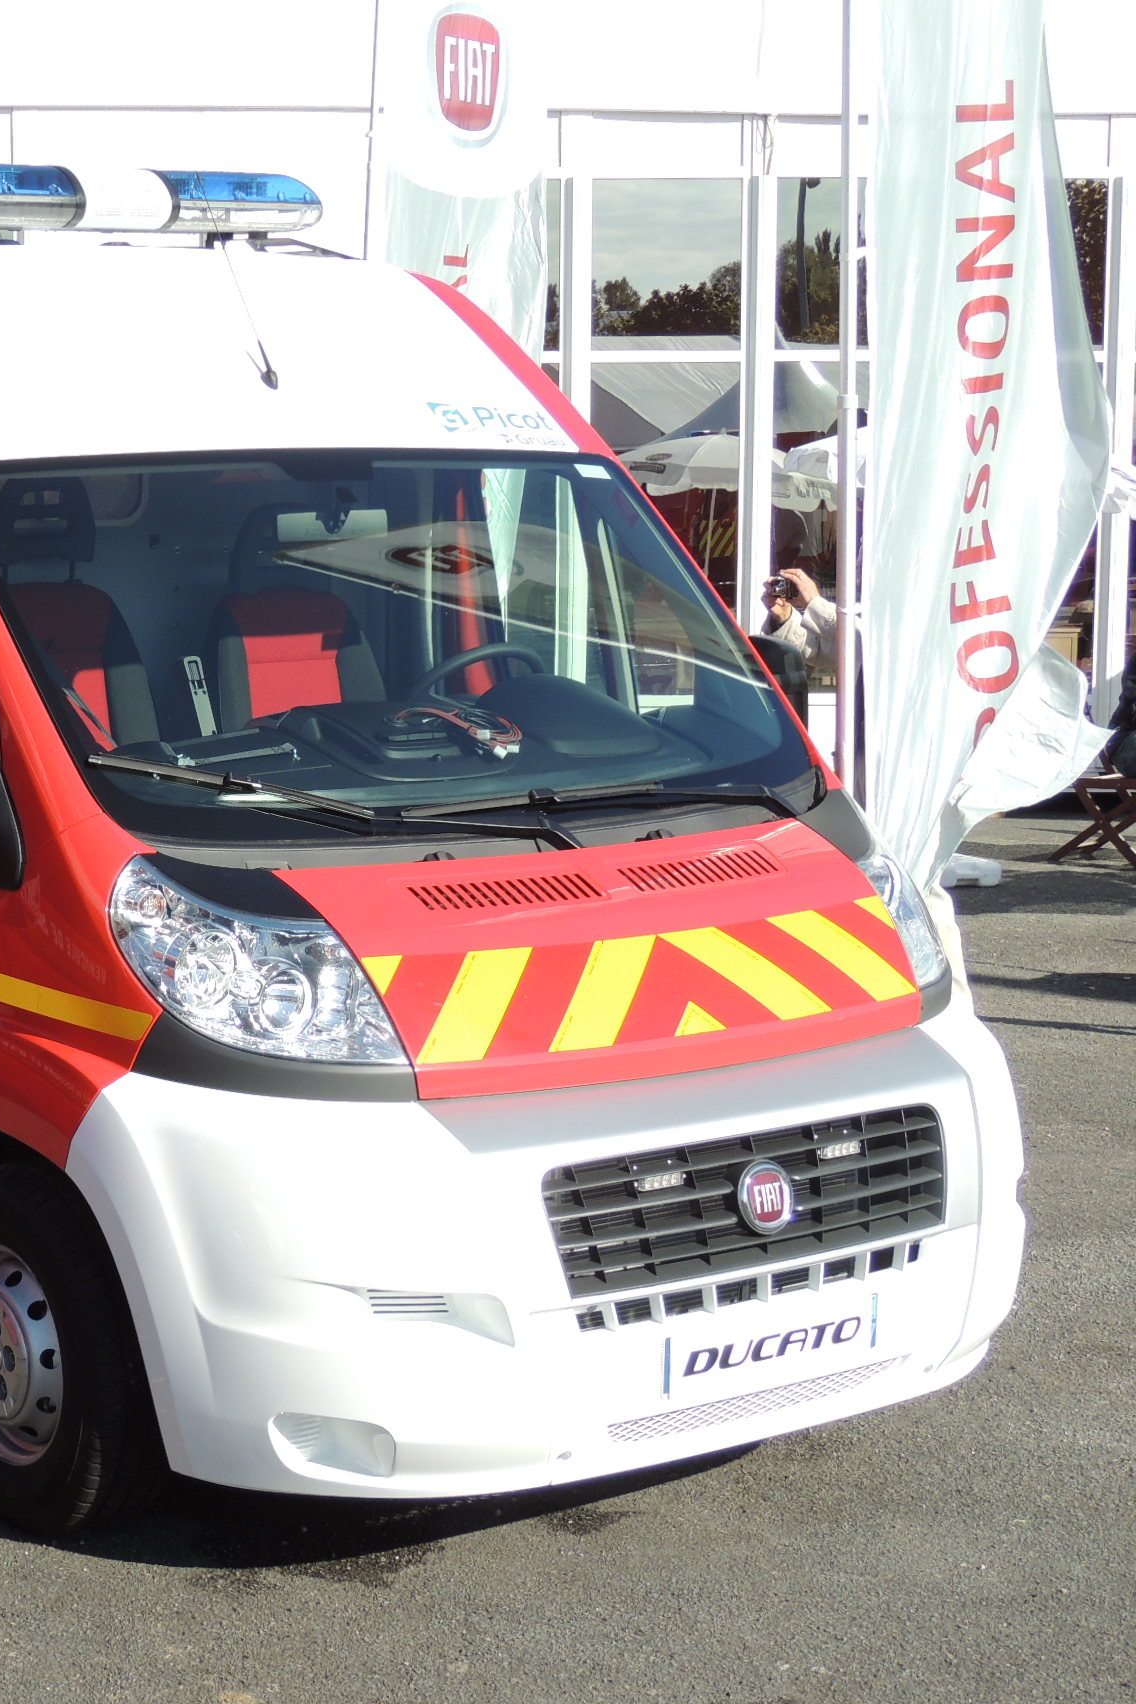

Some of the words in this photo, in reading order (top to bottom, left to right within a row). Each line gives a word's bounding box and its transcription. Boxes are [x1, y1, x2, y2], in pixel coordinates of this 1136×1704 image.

[443, 35, 496, 107] FIAT
[471, 405, 554, 431] Picot
[753, 1181, 782, 1215] FIAT
[682, 1315, 862, 1378] DUCATO
